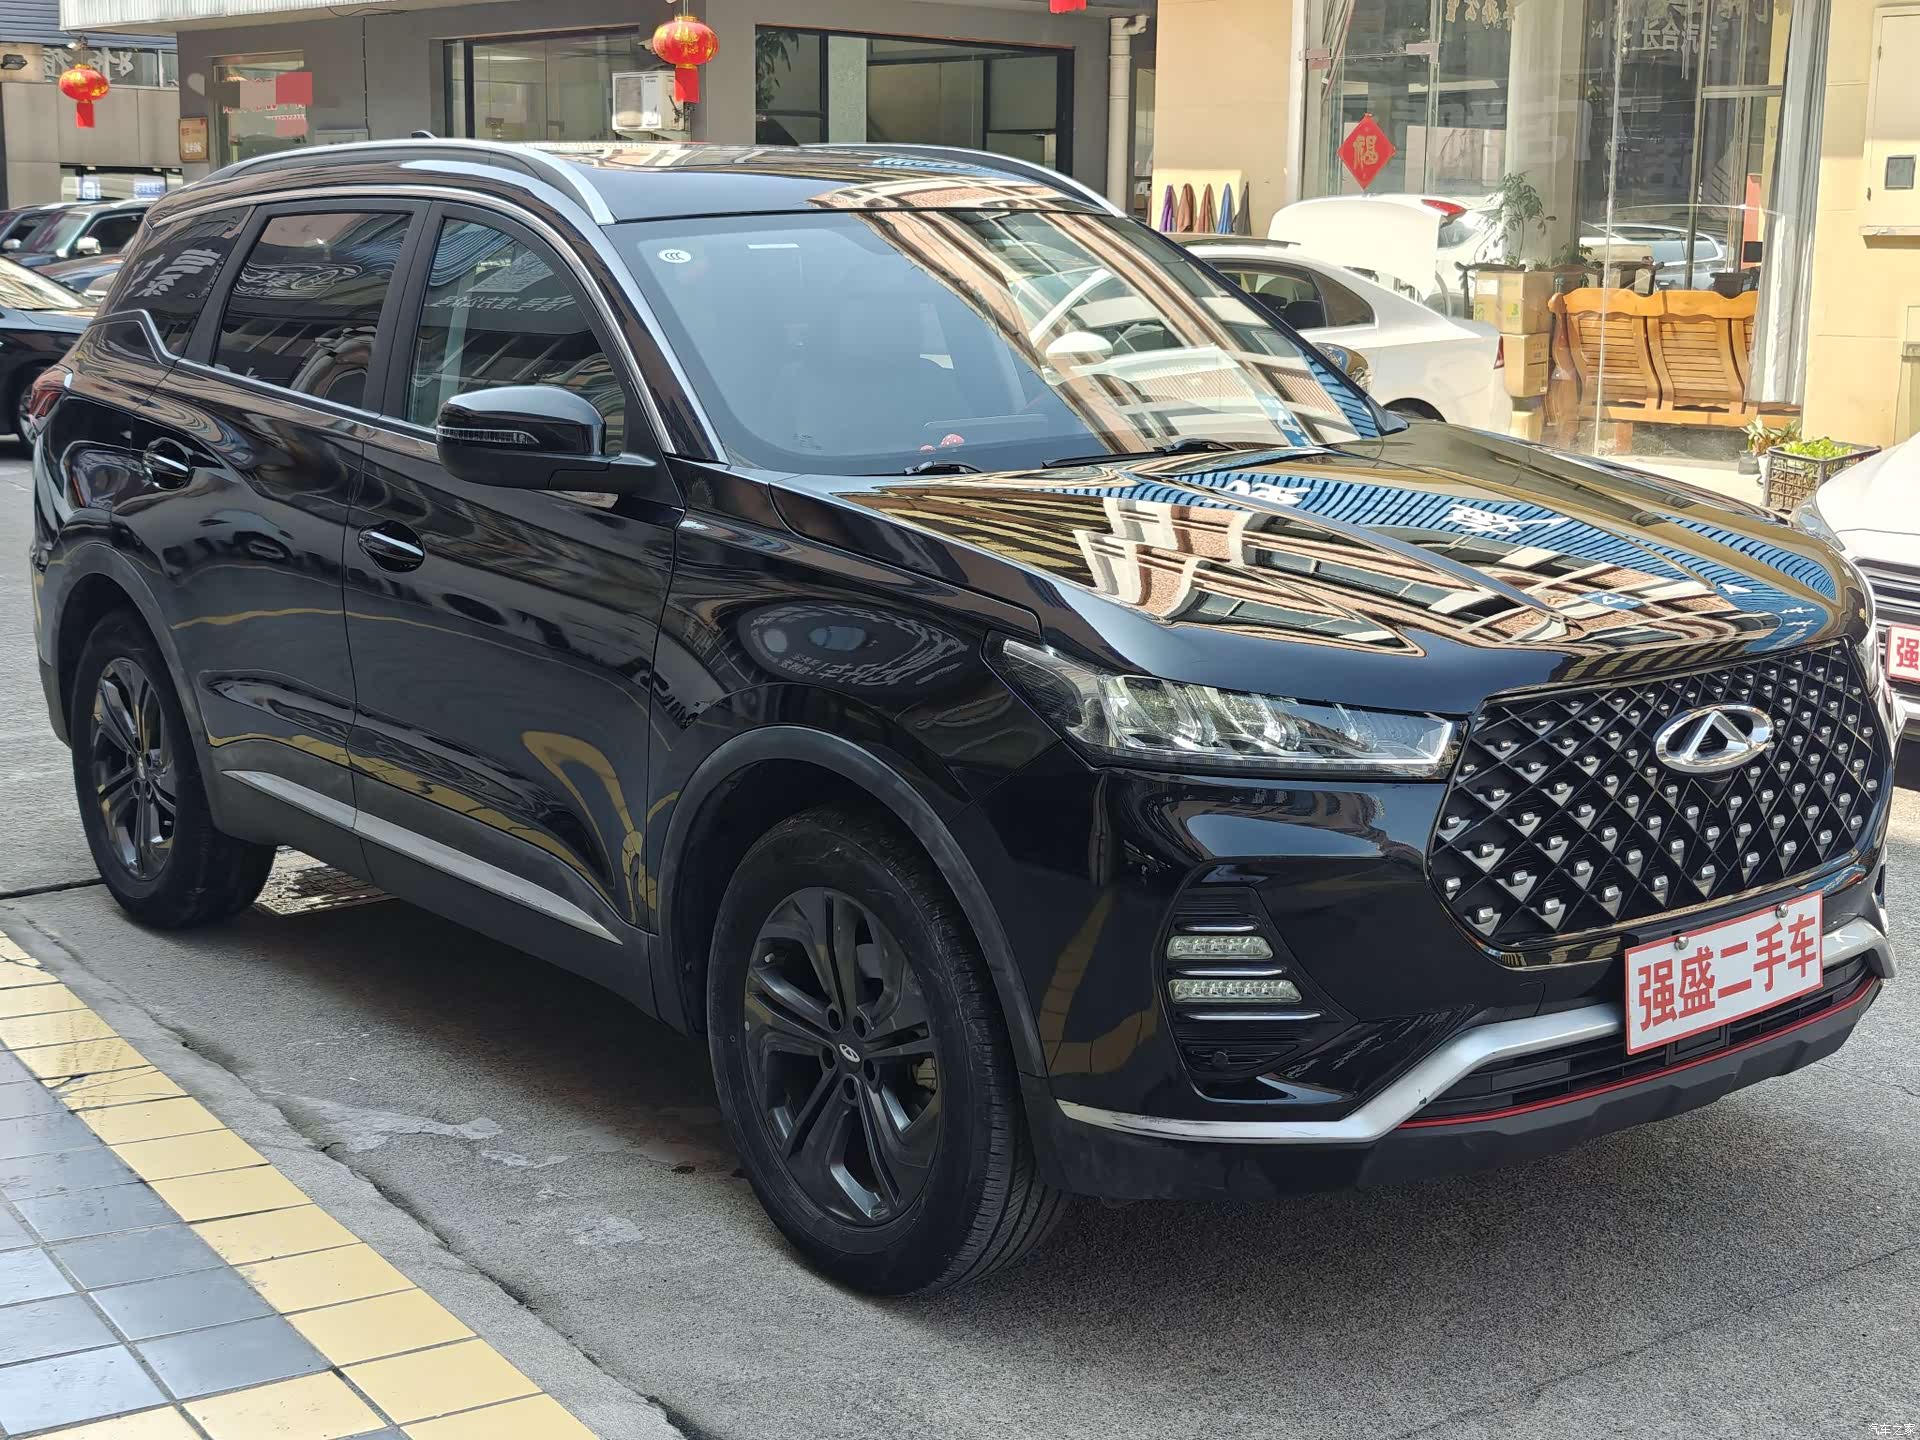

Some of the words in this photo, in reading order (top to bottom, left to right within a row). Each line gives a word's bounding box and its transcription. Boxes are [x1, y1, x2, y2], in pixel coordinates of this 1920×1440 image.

[1353, 135, 1379, 170] 福
[1896, 636, 1920, 670] 强
[1638, 913, 1817, 1032] 强盛二手车
